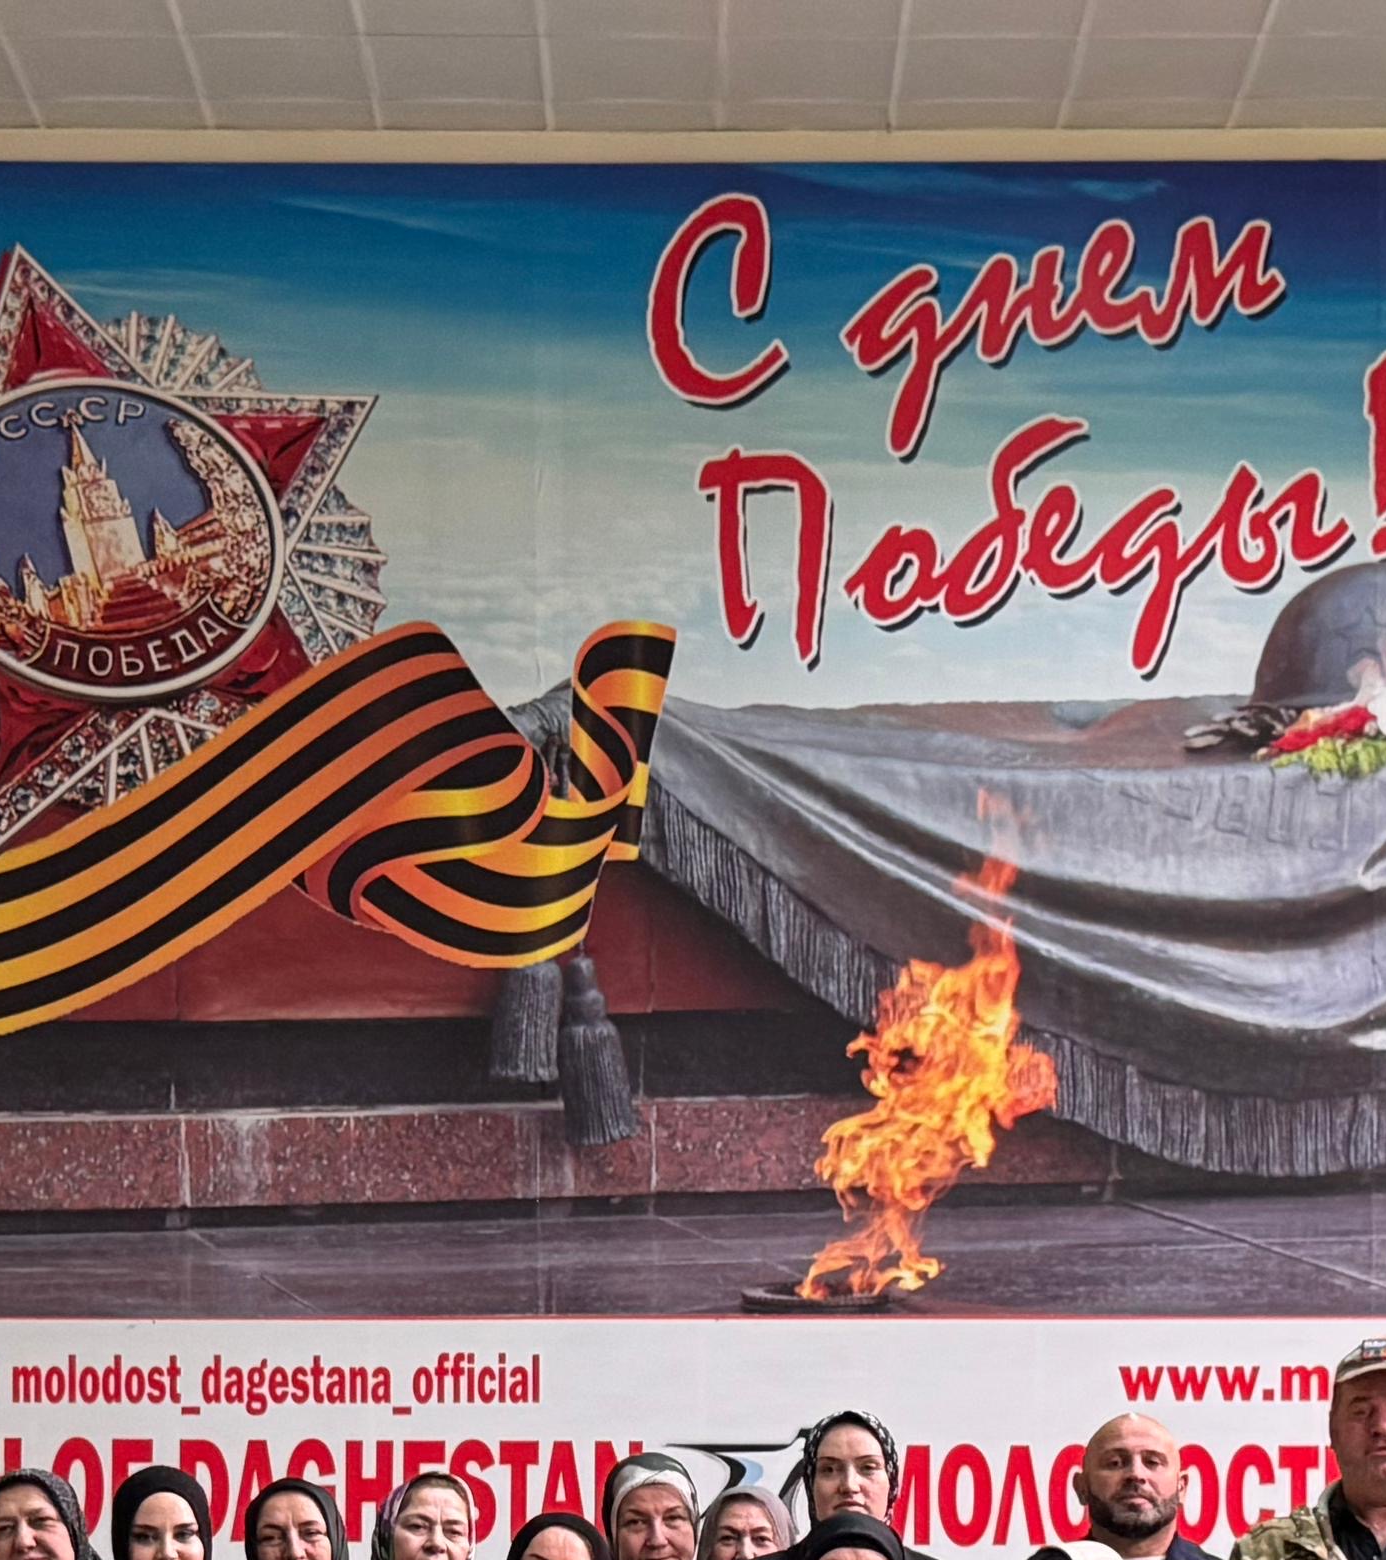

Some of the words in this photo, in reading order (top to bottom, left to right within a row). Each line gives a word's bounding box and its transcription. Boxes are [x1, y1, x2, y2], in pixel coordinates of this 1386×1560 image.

[647, 192, 788, 405] С
[841, 215, 1286, 458] днем
[53, 614, 229, 677] ПОБЕДА
[12, 1352, 541, 1416] molodost_dagestana_official
[892, 1442, 1345, 1548] ОЛООСТ
